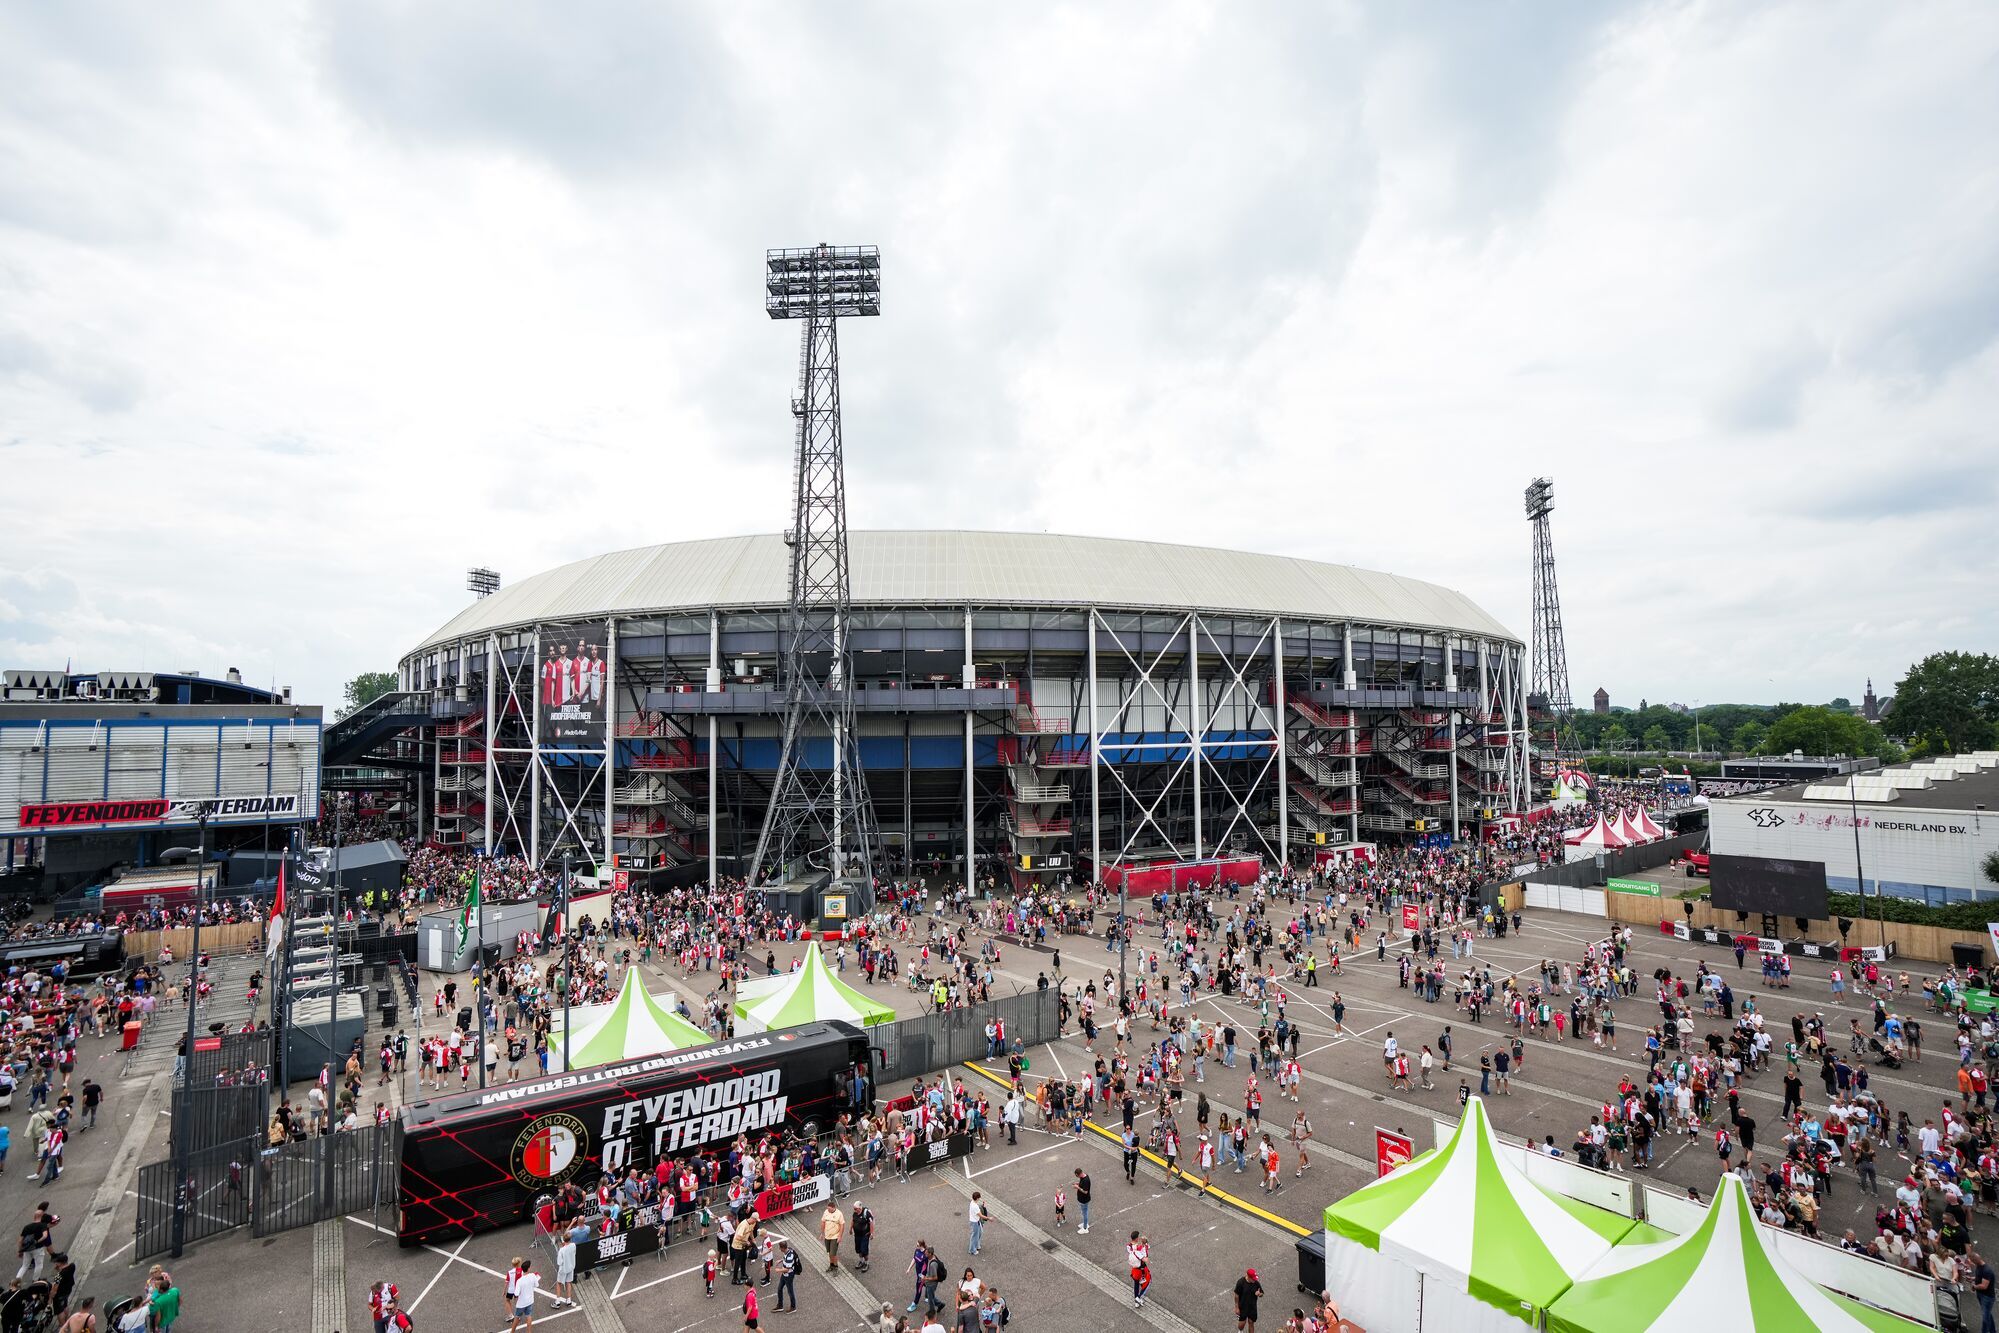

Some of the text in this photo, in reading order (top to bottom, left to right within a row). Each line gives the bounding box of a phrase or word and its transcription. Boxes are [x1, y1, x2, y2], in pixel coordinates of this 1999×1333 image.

[561, 704, 581, 713] TROTSE
[24, 801, 165, 825] FEYENOORD
[1875, 821, 1946, 834] NEDERLAND
[1949, 825, 1967, 835] B.V.
[1610, 882, 1650, 891] NOODUITGANG
[481, 1037, 773, 1106] FEYENOORD ROTTERDAM
[601, 1069, 781, 1140] FEYENOORD
[517, 1116, 583, 1148] FEYENOORD
[928, 1138, 949, 1152] SINCE
[929, 1147, 948, 1160] 1908
[767, 1181, 817, 1203] FEYENOORD
[767, 1189, 819, 1212] ROTTERDAM
[597, 1232, 628, 1250] SINCE
[599, 1243, 627, 1259] 1908
